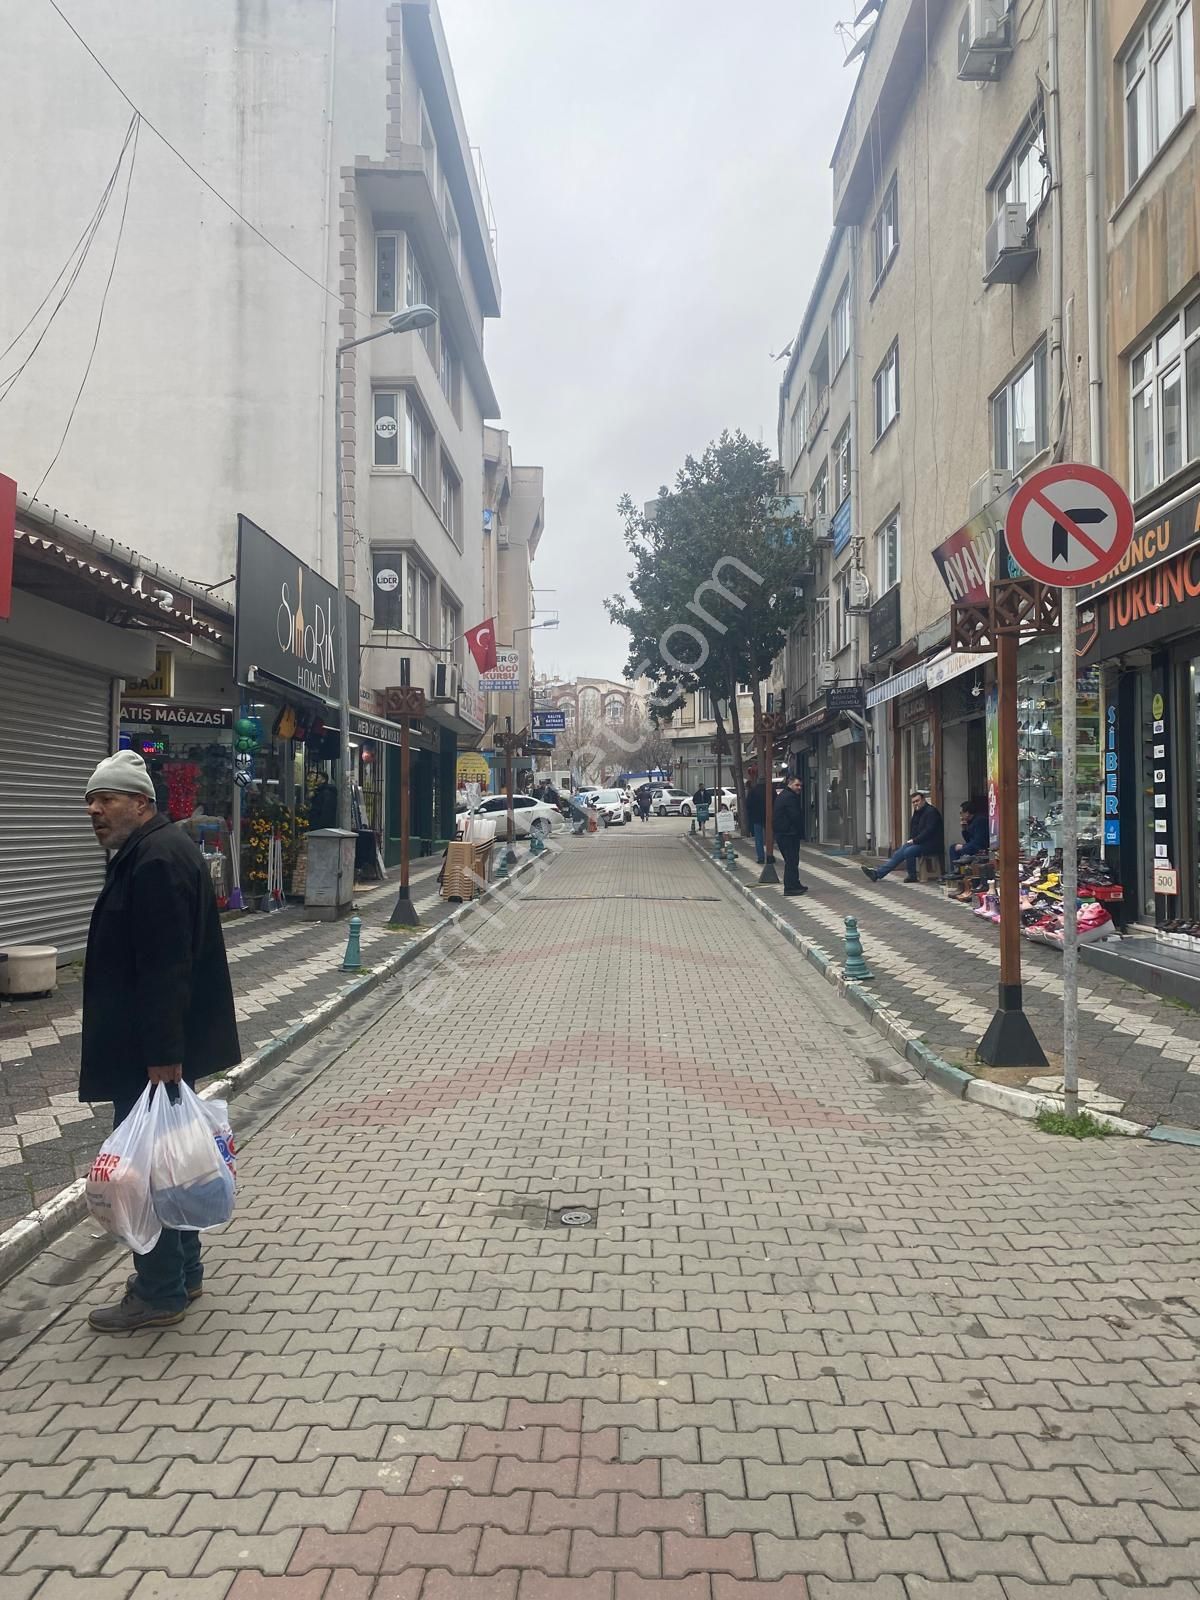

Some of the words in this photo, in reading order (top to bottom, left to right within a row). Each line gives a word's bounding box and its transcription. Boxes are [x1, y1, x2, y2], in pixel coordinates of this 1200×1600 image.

[297, 665, 323, 693] HOME
[482, 672, 516, 680] KURSU
[155, 708, 226, 725] MAĞAZASI
[1105, 705, 1119, 815] SİBER
[1157, 876, 1173, 887] 500
